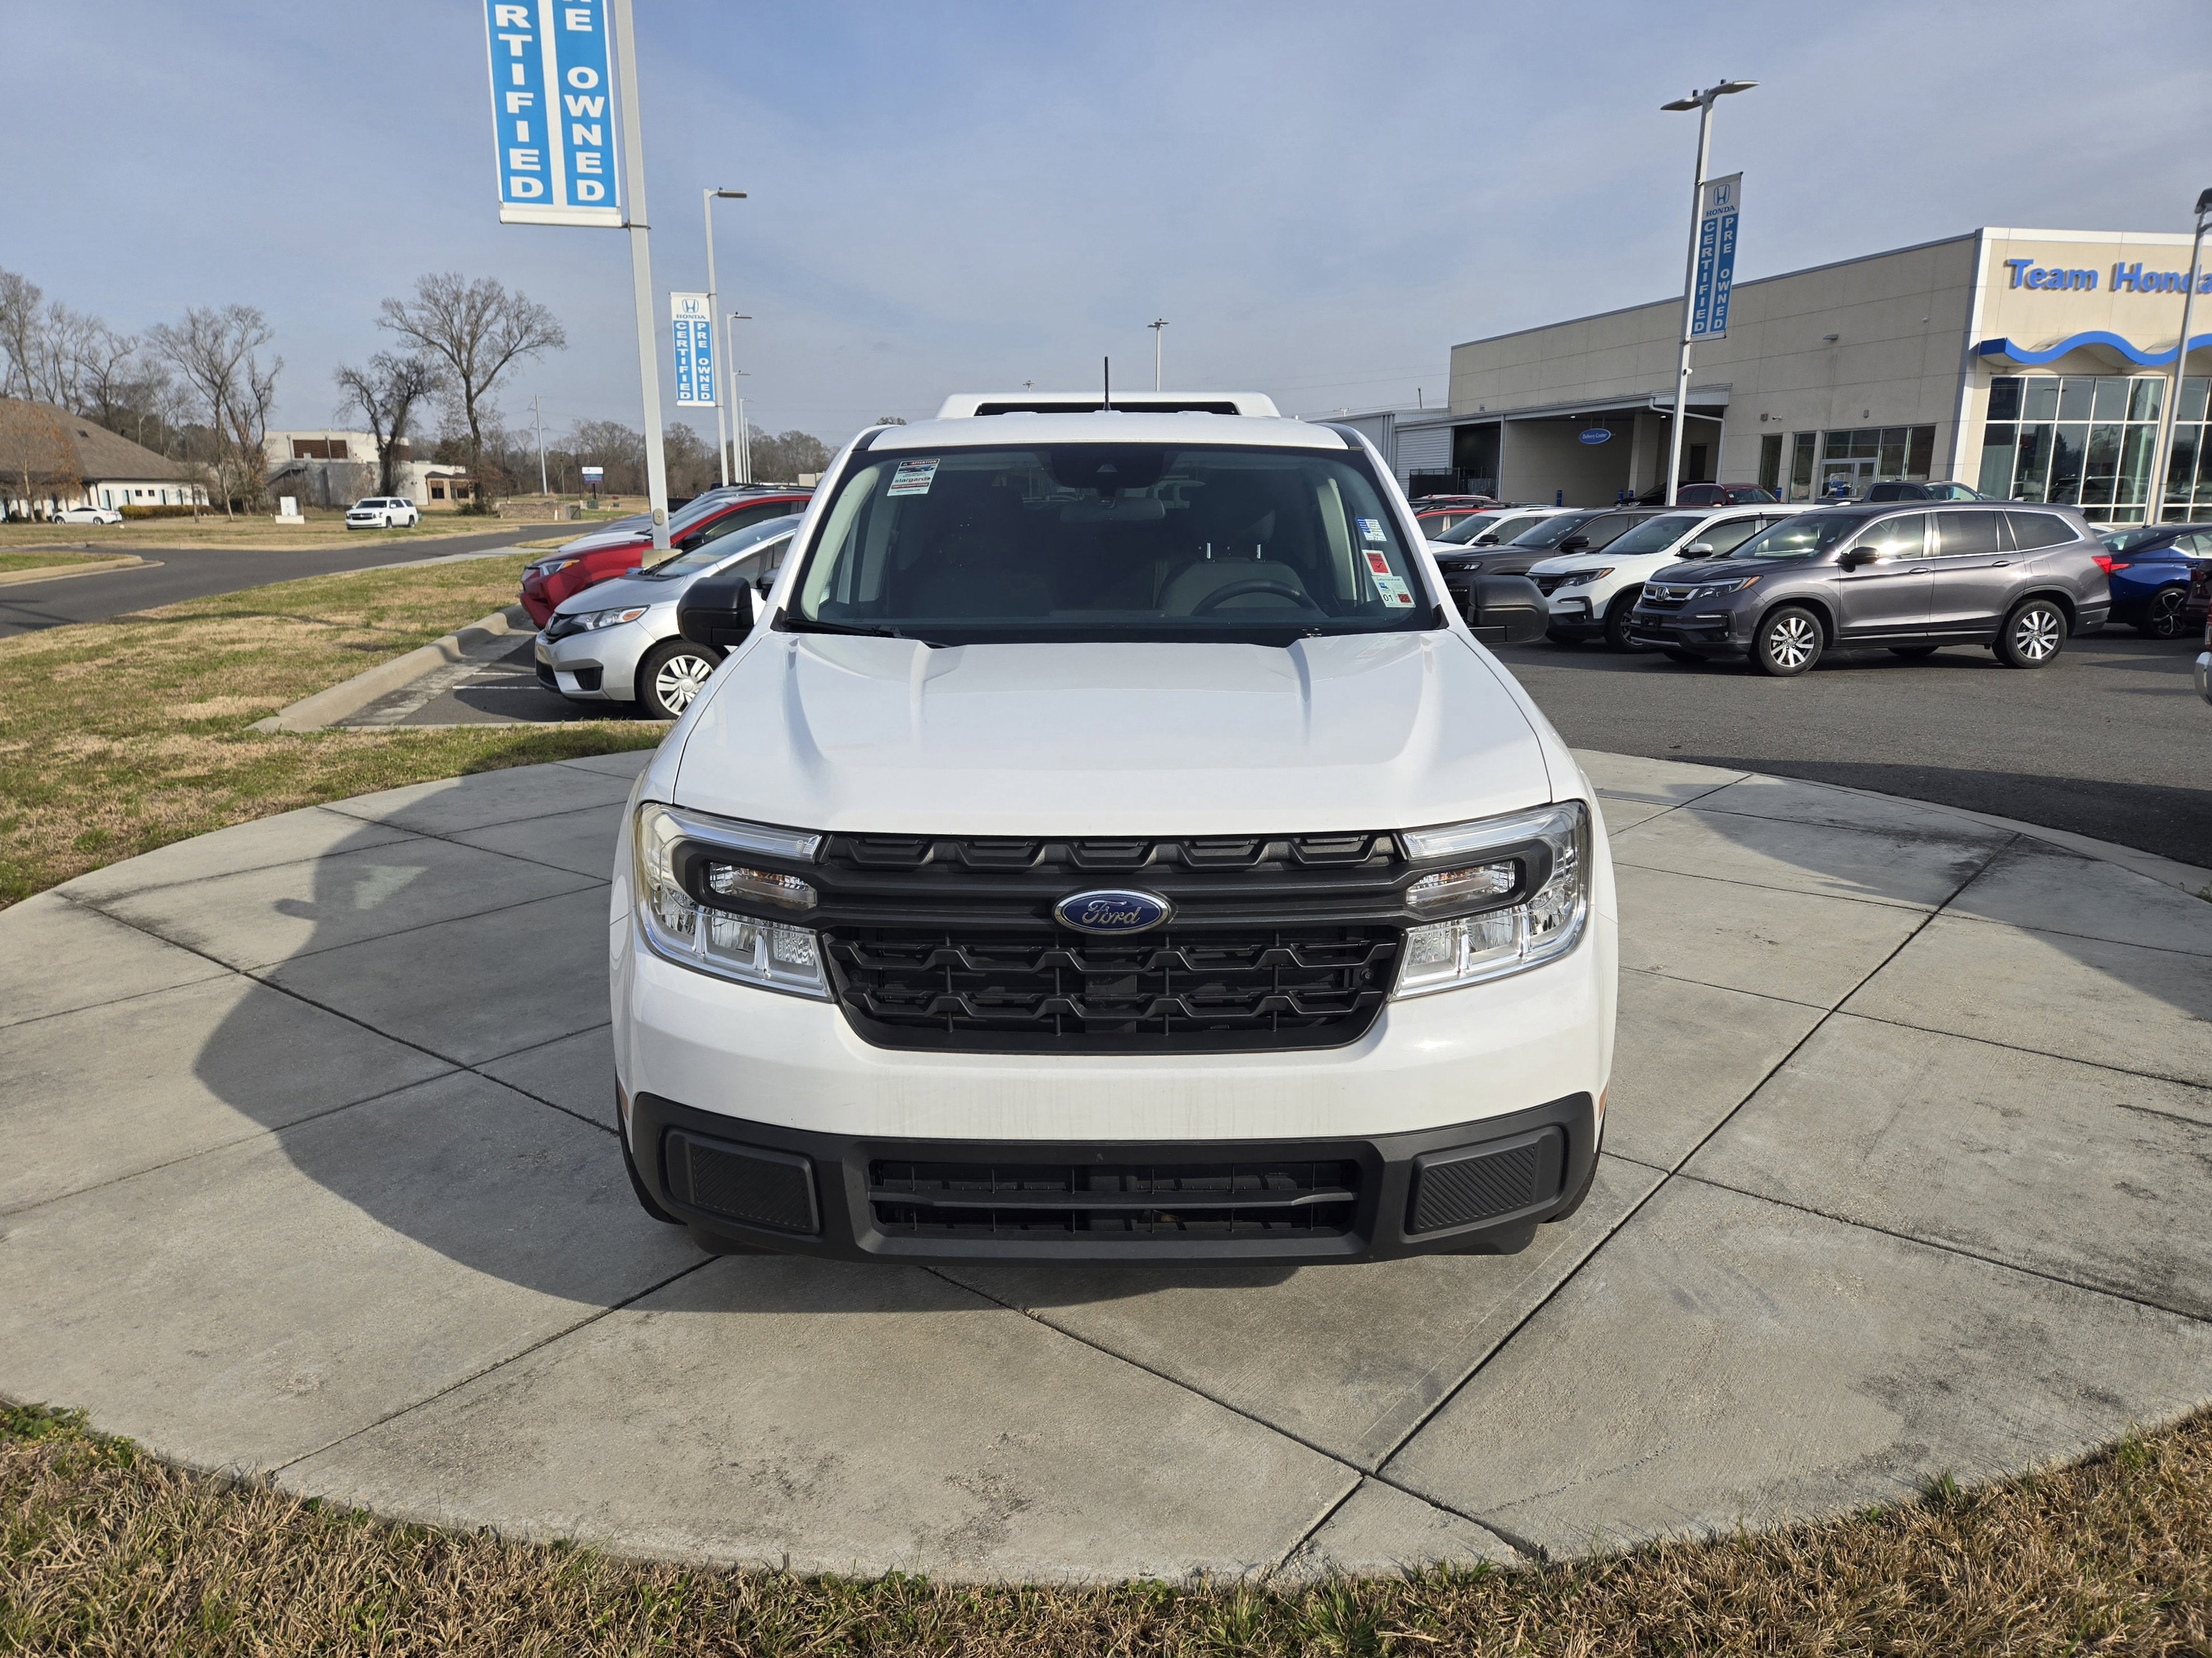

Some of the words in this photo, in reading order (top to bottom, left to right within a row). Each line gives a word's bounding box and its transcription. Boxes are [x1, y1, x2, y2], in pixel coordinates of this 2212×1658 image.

[563, 0, 593, 32] E
[564, 66, 605, 201] OWNED
[1706, 205, 1736, 217] HONDA
[1723, 216, 1734, 255] PRE
[1694, 221, 1716, 332] CERTIFIED
[2007, 259, 2099, 290] Team
[1713, 268, 1730, 329] OWNED
[697, 323, 708, 348] PRE
[675, 322, 691, 399] CERTIFIED
[697, 357, 711, 400] OWNED
[1082, 900, 1142, 924] Ford
